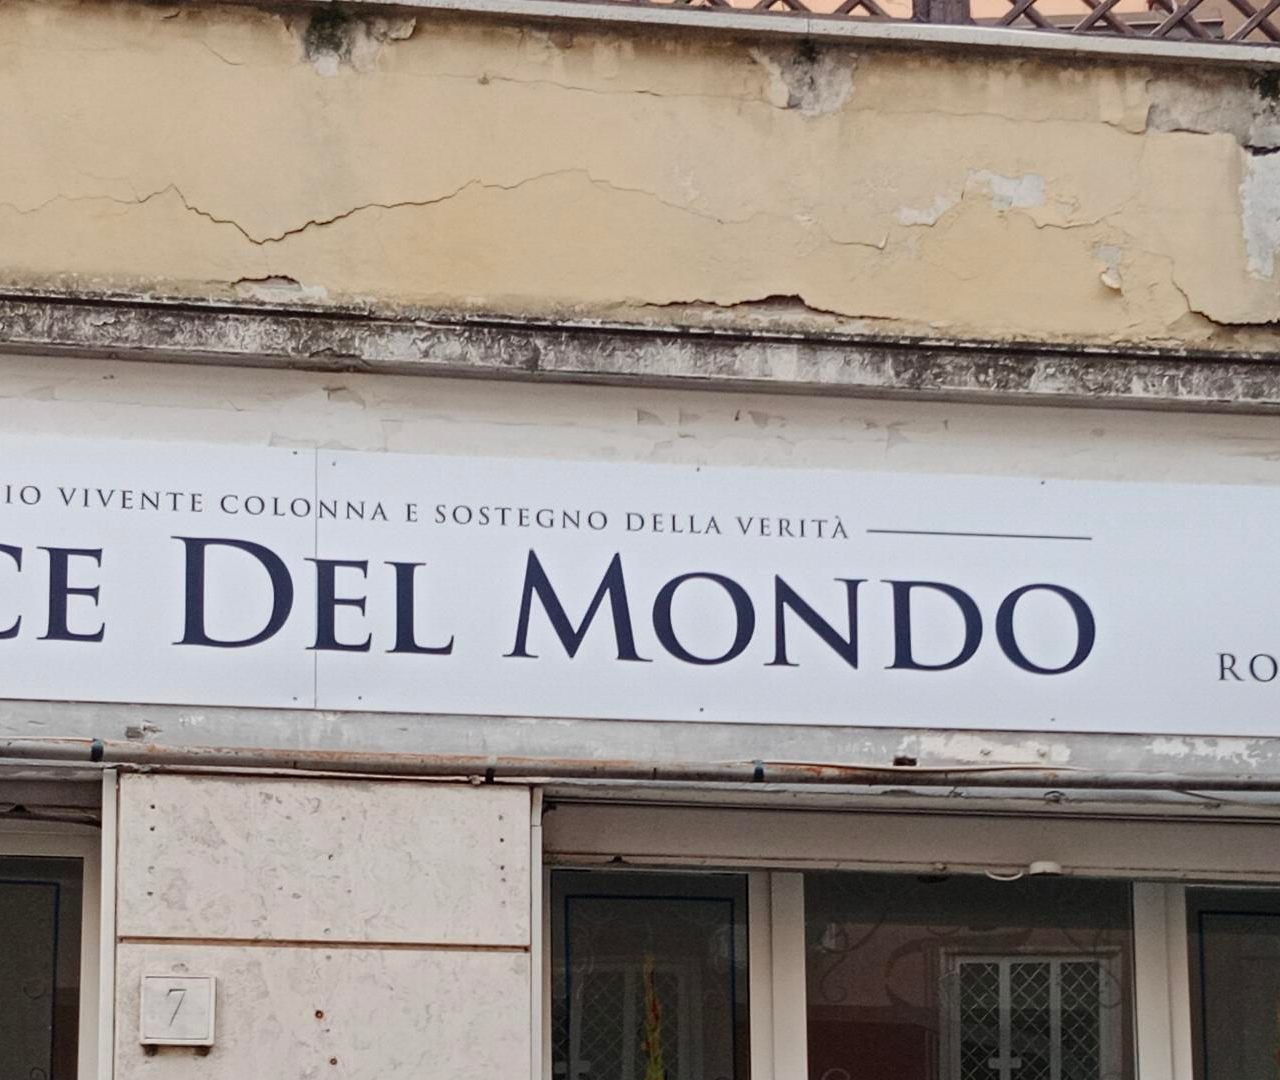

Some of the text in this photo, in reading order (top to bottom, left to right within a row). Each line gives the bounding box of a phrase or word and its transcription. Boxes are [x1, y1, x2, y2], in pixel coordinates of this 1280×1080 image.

[57, 486, 204, 514] VIVENTE
[219, 493, 389, 522] COLONNA
[405, 502, 419, 523] E
[434, 504, 609, 532] SOSTEGNO
[624, 511, 722, 536] DELLA
[735, 515, 849, 540] VERITÀ
[501, 548, 1097, 677] MONDO
[166, 988, 188, 1027] 7
